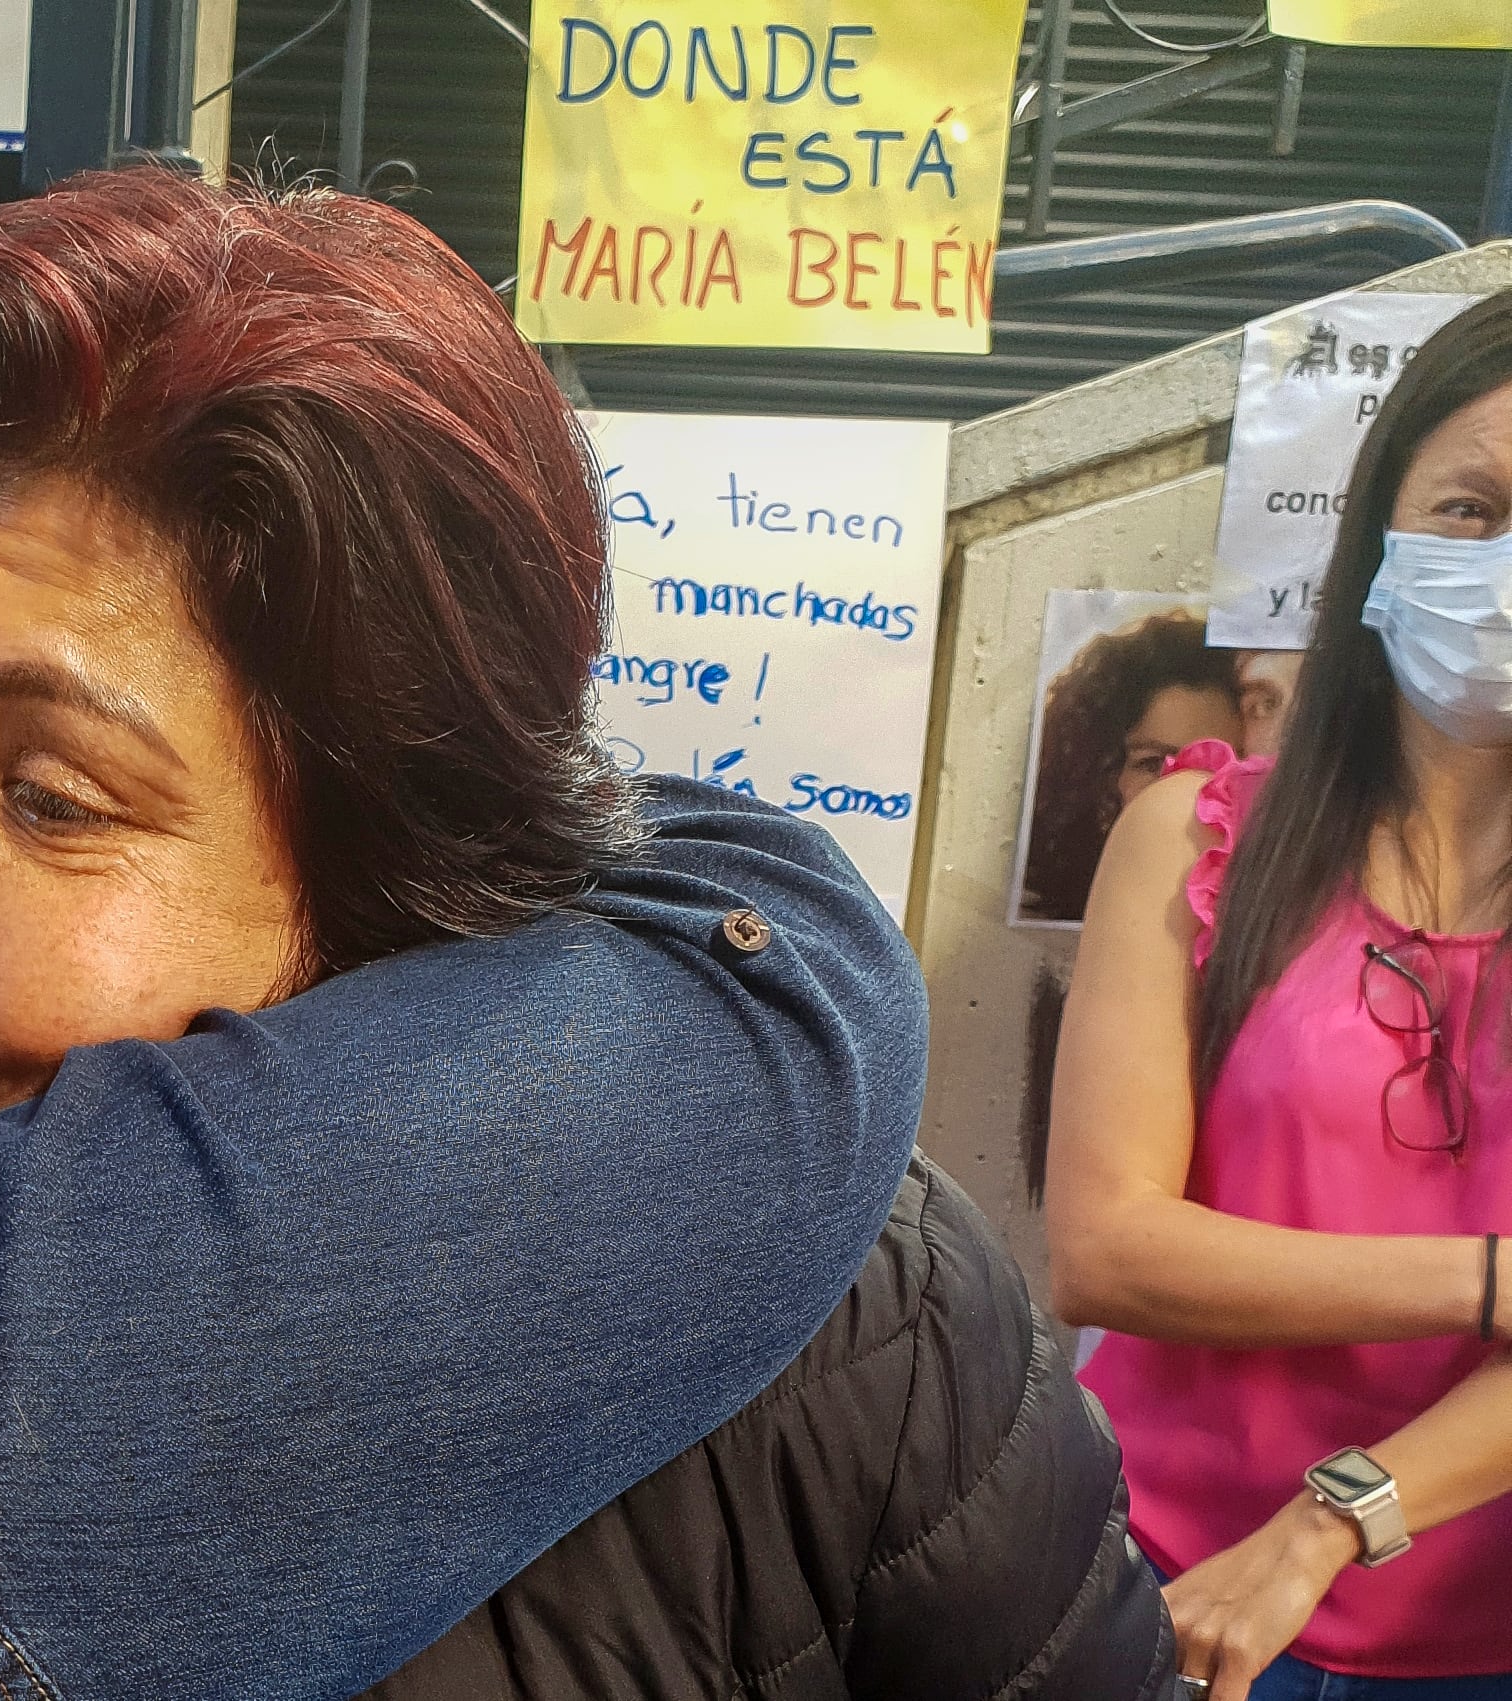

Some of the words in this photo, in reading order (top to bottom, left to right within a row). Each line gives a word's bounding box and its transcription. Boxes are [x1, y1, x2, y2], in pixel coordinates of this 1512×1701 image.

[557, 17, 875, 106] DONDE
[742, 107, 956, 199] ESTÁ
[530, 200, 742, 309] MARÍA
[788, 225, 994, 328] BELÉN
[716, 471, 904, 548] tienen
[651, 576, 918, 642] manchadas
[1268, 586, 1290, 618] y
